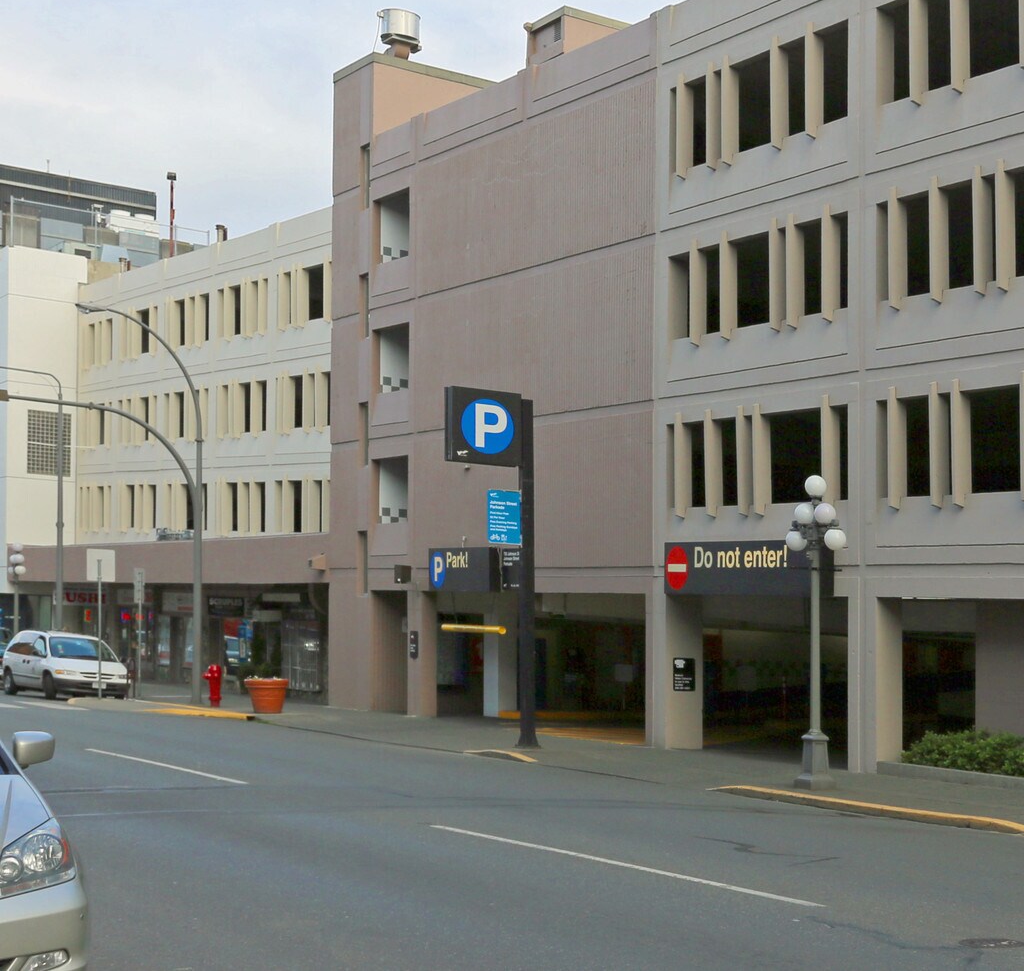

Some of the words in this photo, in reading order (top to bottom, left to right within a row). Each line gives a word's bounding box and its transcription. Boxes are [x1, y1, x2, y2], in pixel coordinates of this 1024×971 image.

[475, 403, 508, 448] P
[434, 556, 443, 582] P
[446, 551, 468, 568] Park!
[694, 546, 713, 569] Do
[717, 546, 740, 569] not
[744, 544, 788, 569] enter!
